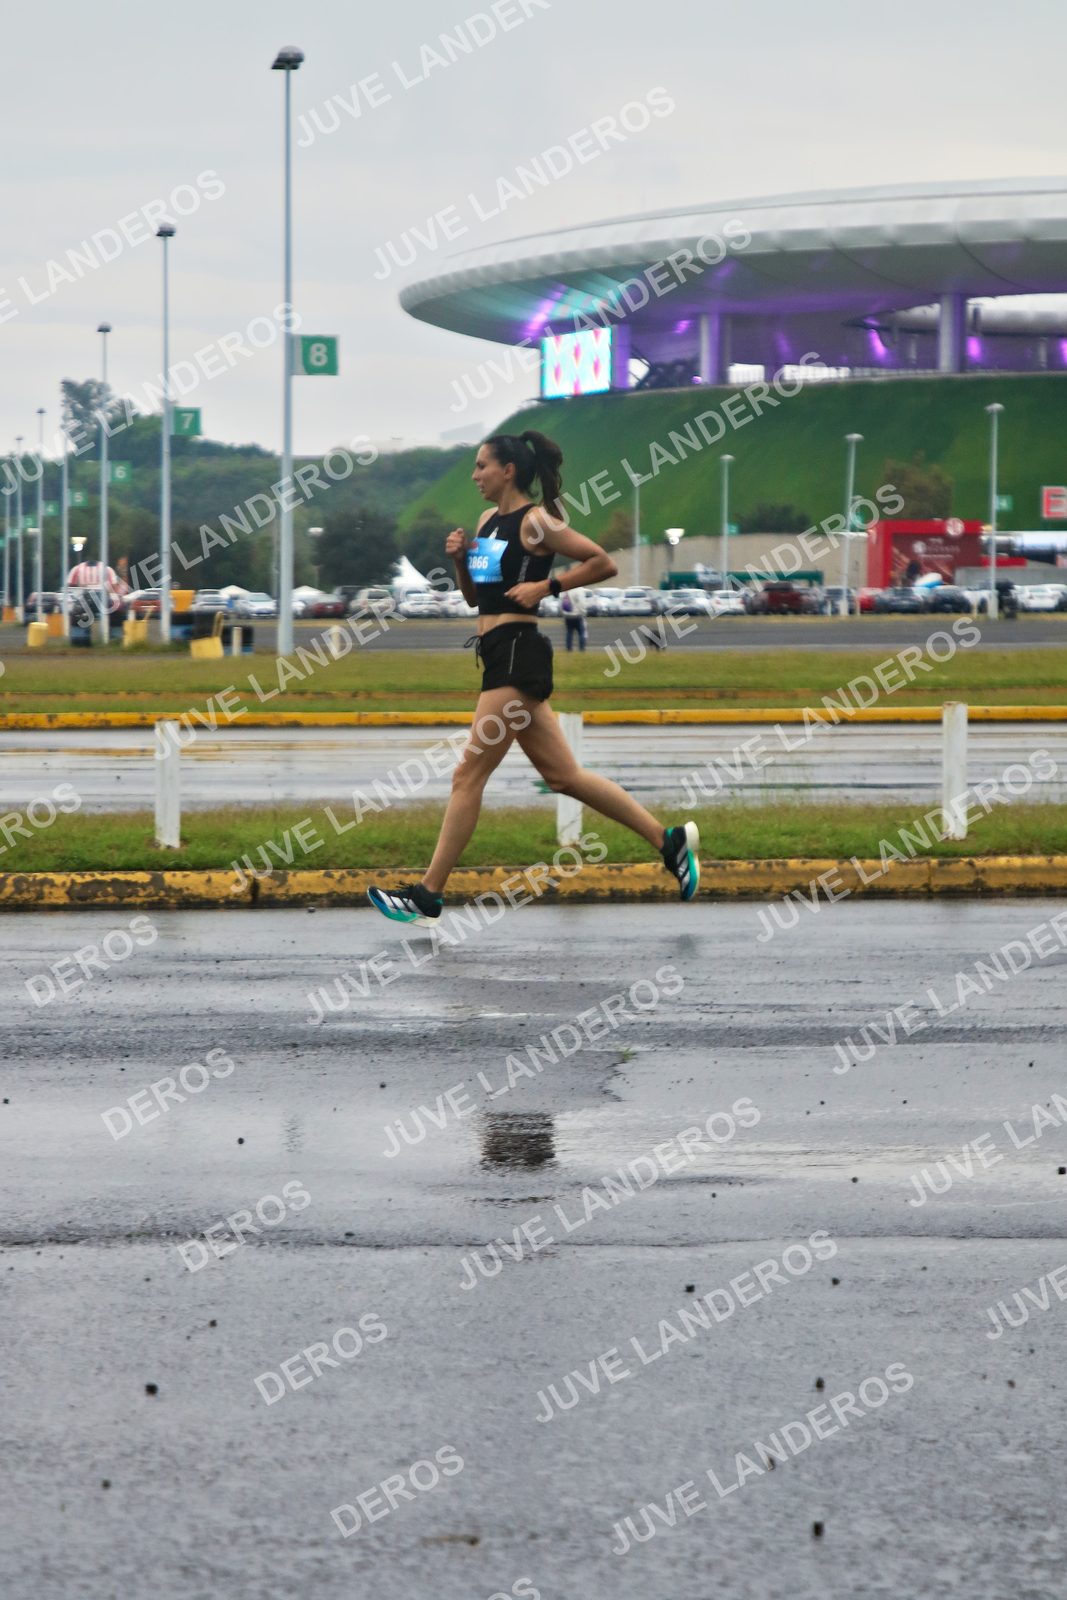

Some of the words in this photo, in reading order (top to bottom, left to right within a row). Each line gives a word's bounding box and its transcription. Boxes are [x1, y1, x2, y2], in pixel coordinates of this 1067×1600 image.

[309, 343, 328, 366] 8
[181, 413, 194, 429] 7
[114, 466, 126, 479] 6
[468, 556, 488, 569] 2866
